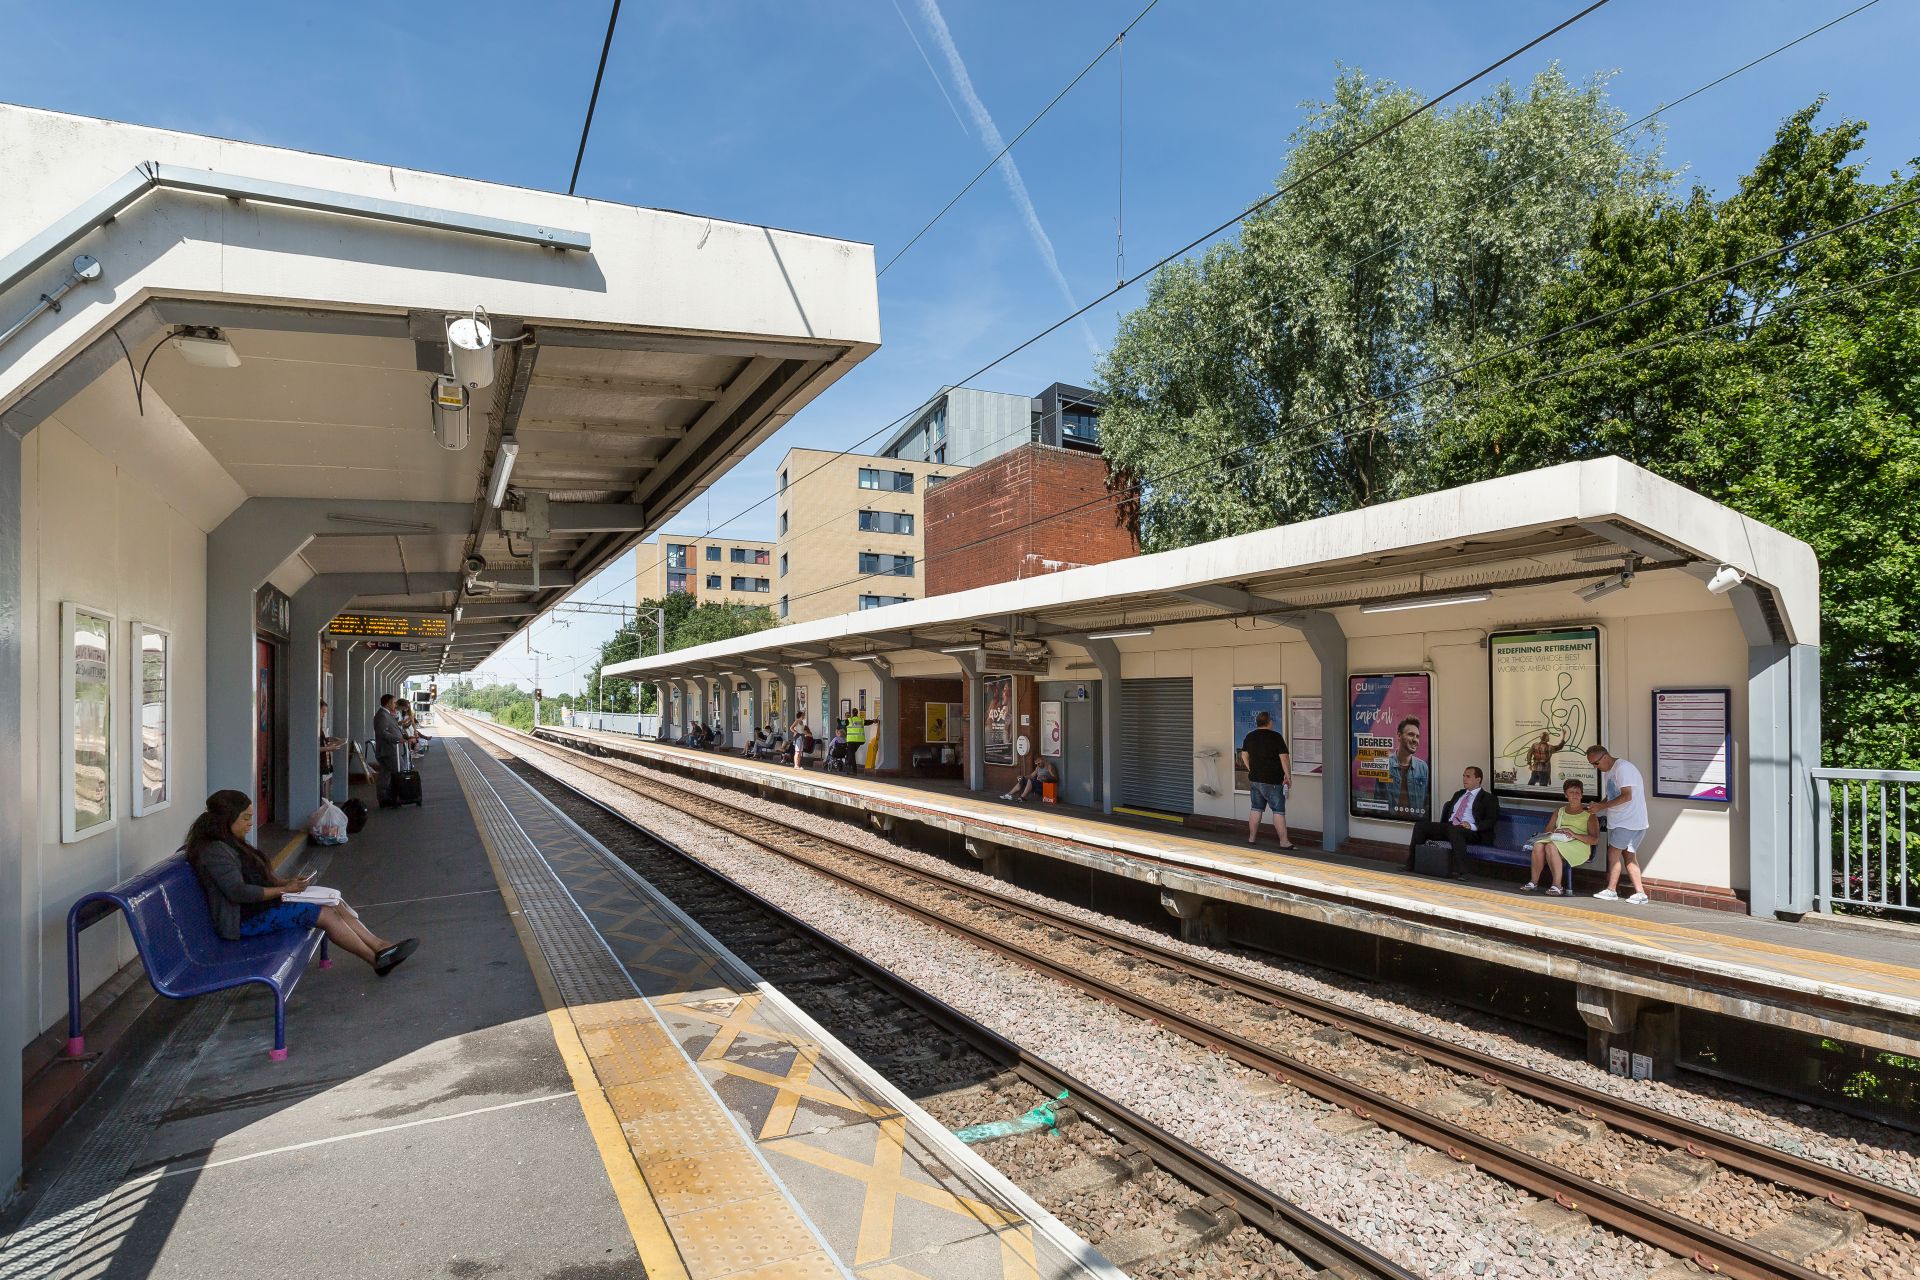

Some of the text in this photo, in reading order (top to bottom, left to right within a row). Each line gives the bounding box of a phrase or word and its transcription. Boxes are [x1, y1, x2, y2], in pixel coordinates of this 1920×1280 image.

[1497, 643, 1592, 655] REDEFINING RETIREMENT
[1497, 653, 1581, 664] FOR THOSE WHOSE BEST
[1497, 665, 1518, 673] WORK
[1527, 664, 1551, 672] AHEAD
[1552, 664, 1563, 672] OF
[1565, 663, 1586, 671] THEM
[1355, 706, 1393, 725] capital
[1358, 737, 1393, 748] DEGREES
[1358, 749, 1388, 757] FULL-TIME
